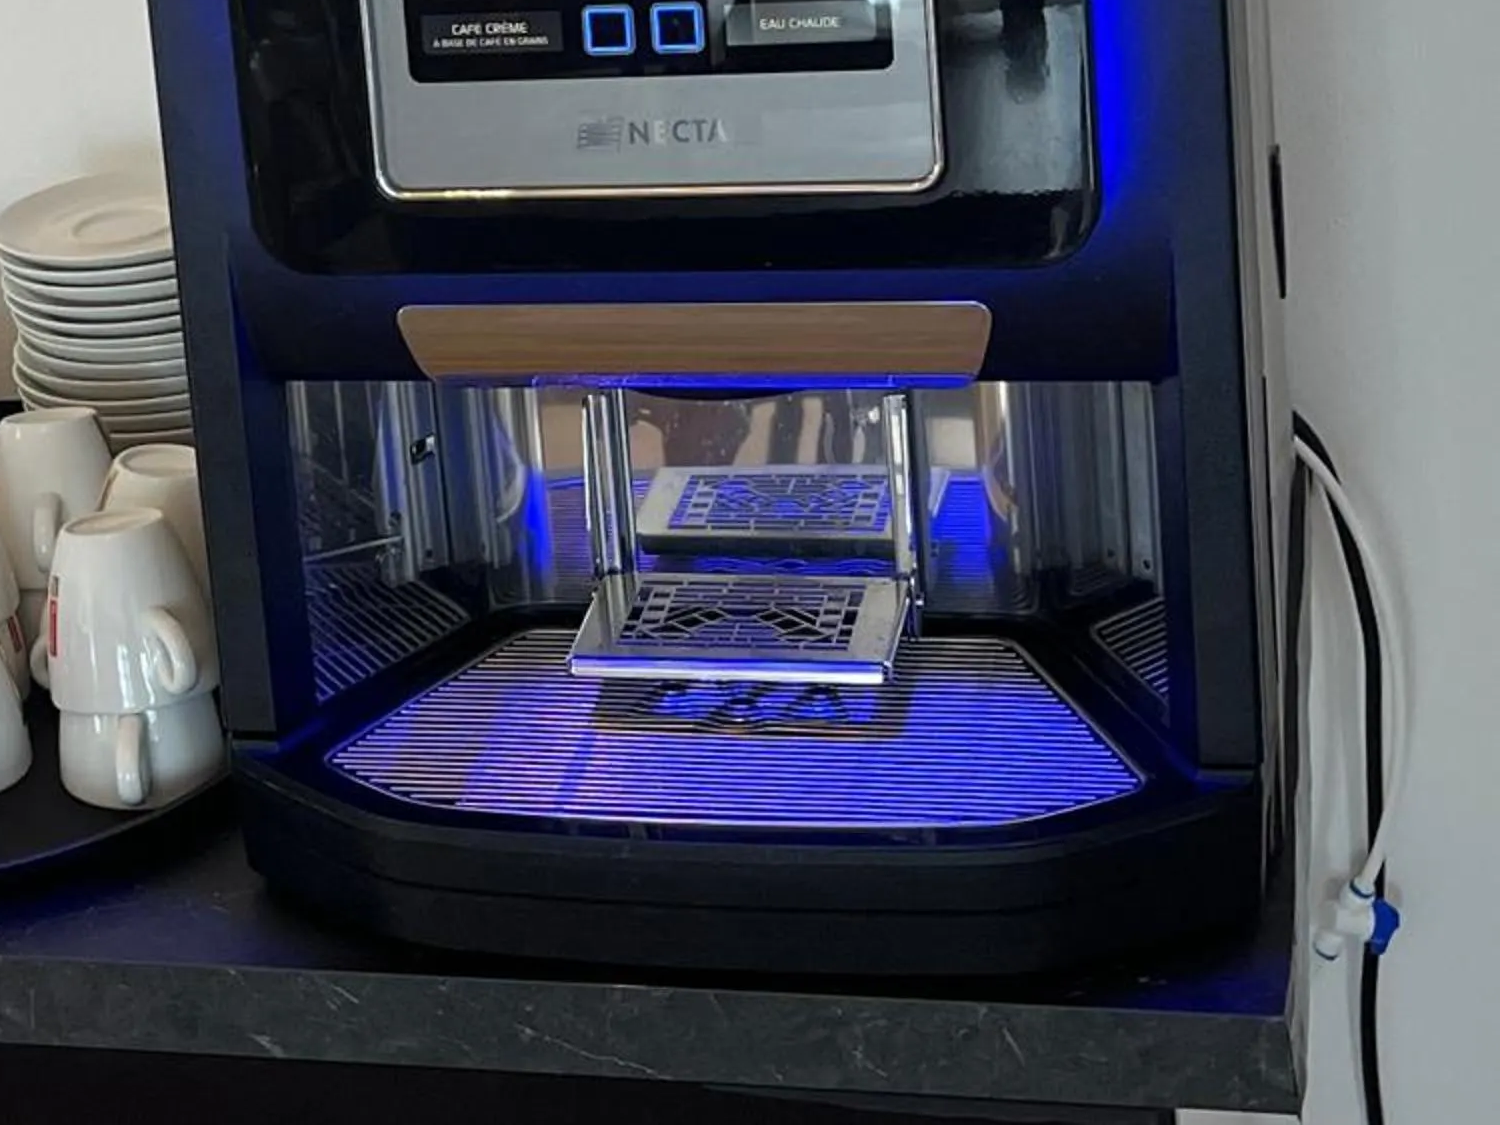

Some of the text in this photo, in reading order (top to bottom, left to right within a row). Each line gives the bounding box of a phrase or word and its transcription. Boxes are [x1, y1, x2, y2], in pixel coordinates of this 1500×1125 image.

[760, 16, 840, 30] EAU CHAUDE
[628, 118, 729, 146] NECTA
